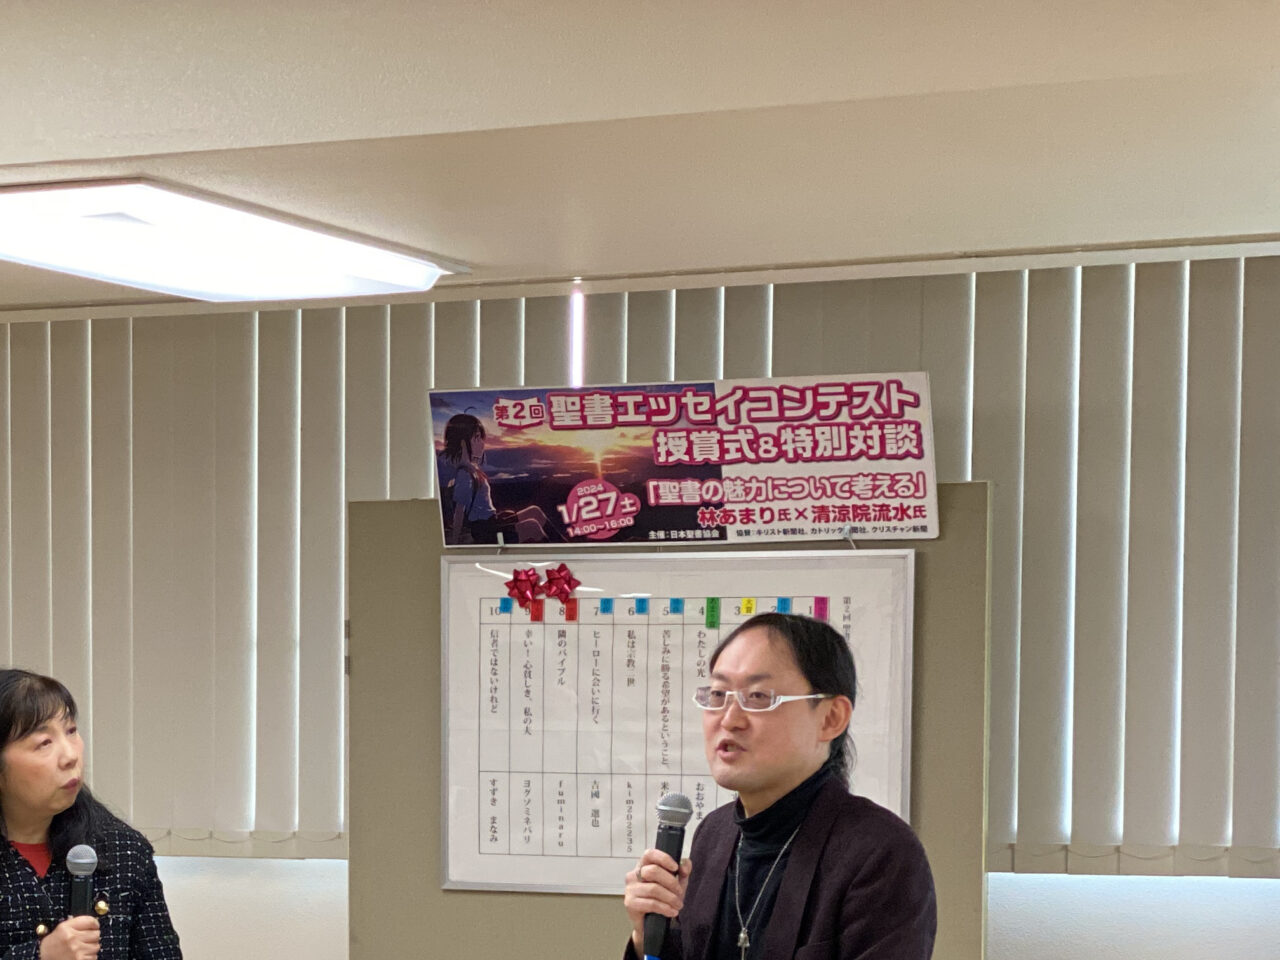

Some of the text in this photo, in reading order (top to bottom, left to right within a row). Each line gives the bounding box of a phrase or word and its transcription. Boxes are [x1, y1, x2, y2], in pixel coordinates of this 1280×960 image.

[494, 381, 919, 428] 第2回 聖書エッセイコンテスト
[576, 483, 604, 496] 2024
[648, 472, 926, 505] 「聖書の魅力について考える」
[557, 491, 637, 524] 1/27 土
